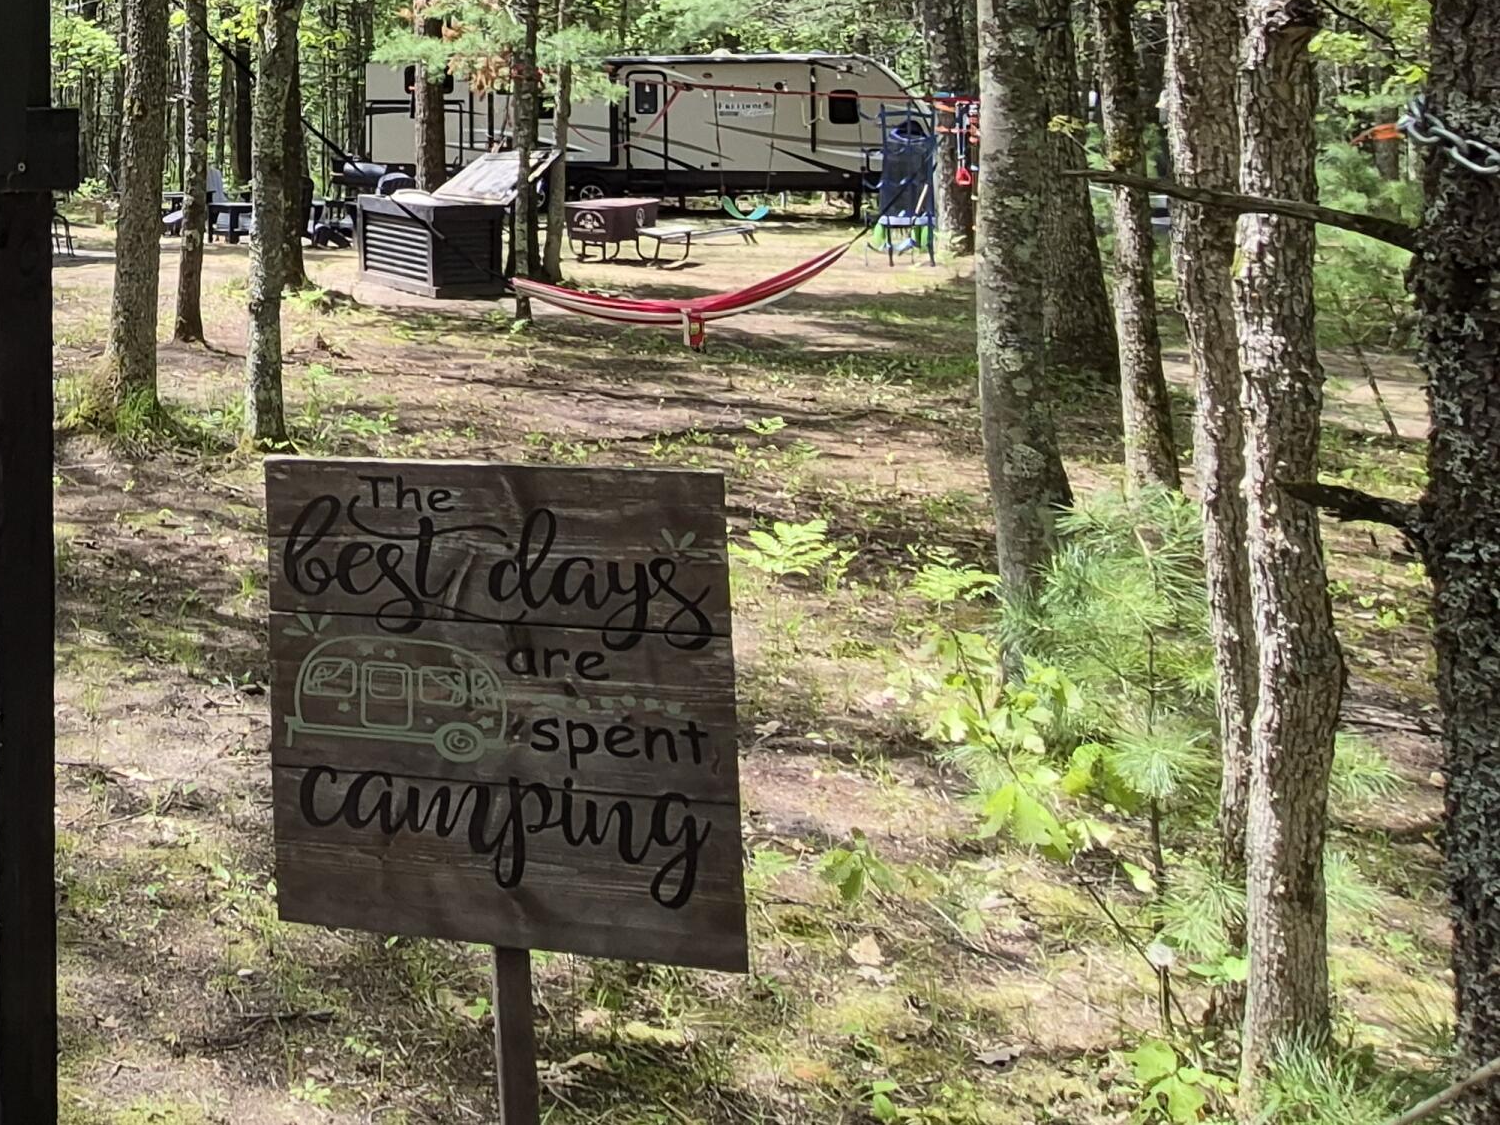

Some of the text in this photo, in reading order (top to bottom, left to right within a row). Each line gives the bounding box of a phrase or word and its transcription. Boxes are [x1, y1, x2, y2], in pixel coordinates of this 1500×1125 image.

[358, 475, 455, 513] The
[283, 494, 712, 651] best days
[506, 646, 610, 681] are
[530, 715, 709, 769] spent
[300, 765, 712, 910] camping
